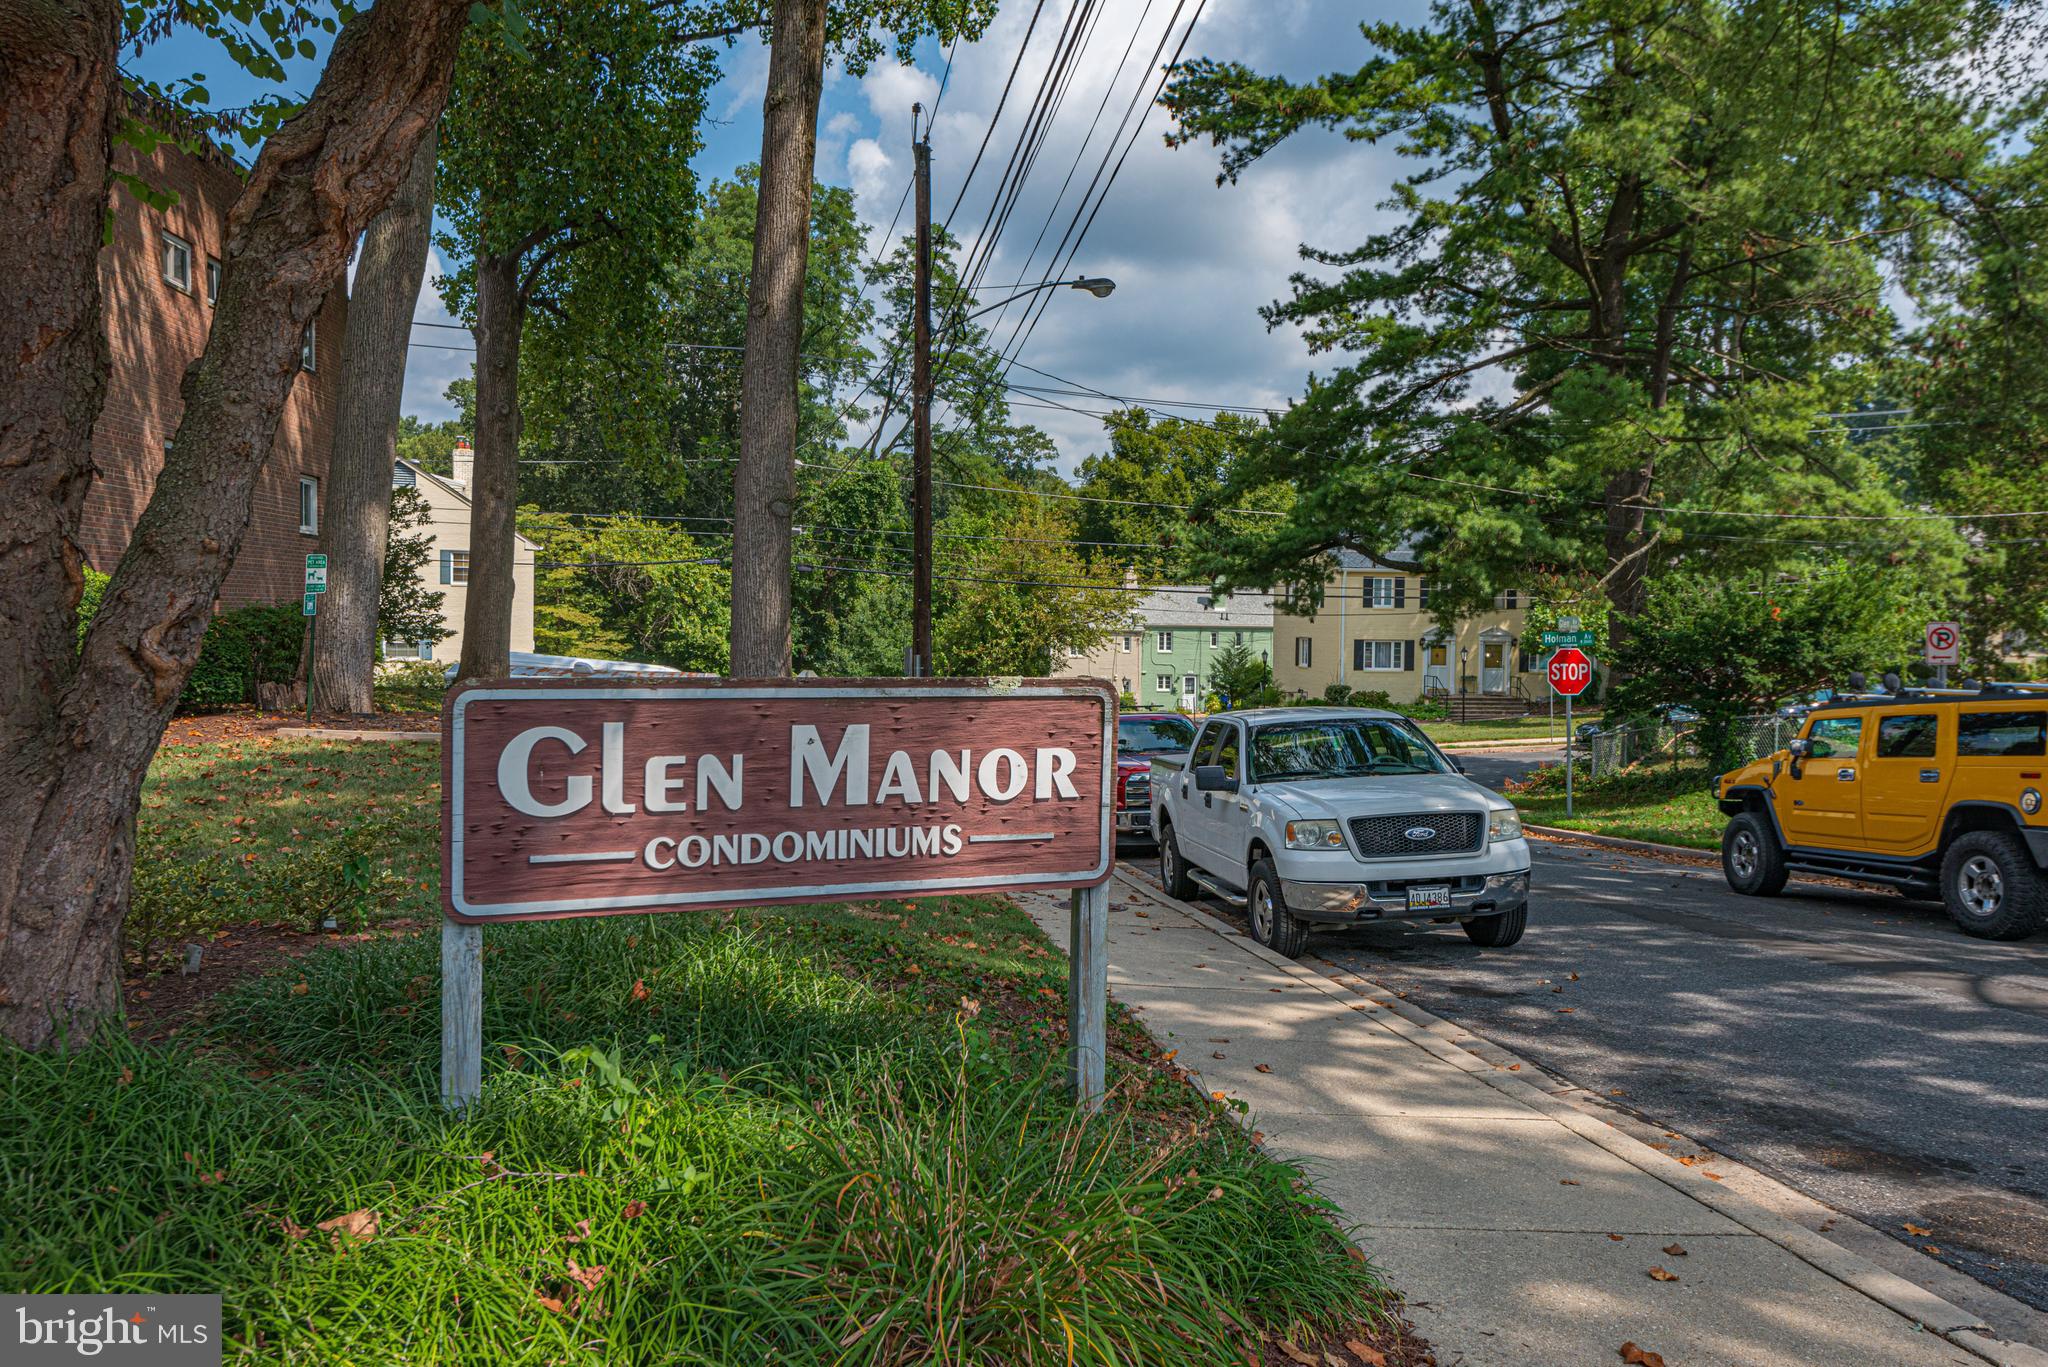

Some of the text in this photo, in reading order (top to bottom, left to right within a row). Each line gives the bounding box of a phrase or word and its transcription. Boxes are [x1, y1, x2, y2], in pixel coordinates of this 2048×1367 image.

[1544, 634, 1577, 643] Holman
[1551, 663, 1588, 680] STOP
[791, 722, 1080, 808] MANOR
[1412, 829, 1429, 837] Ford
[643, 823, 963, 870] CONDOMINIUMS
